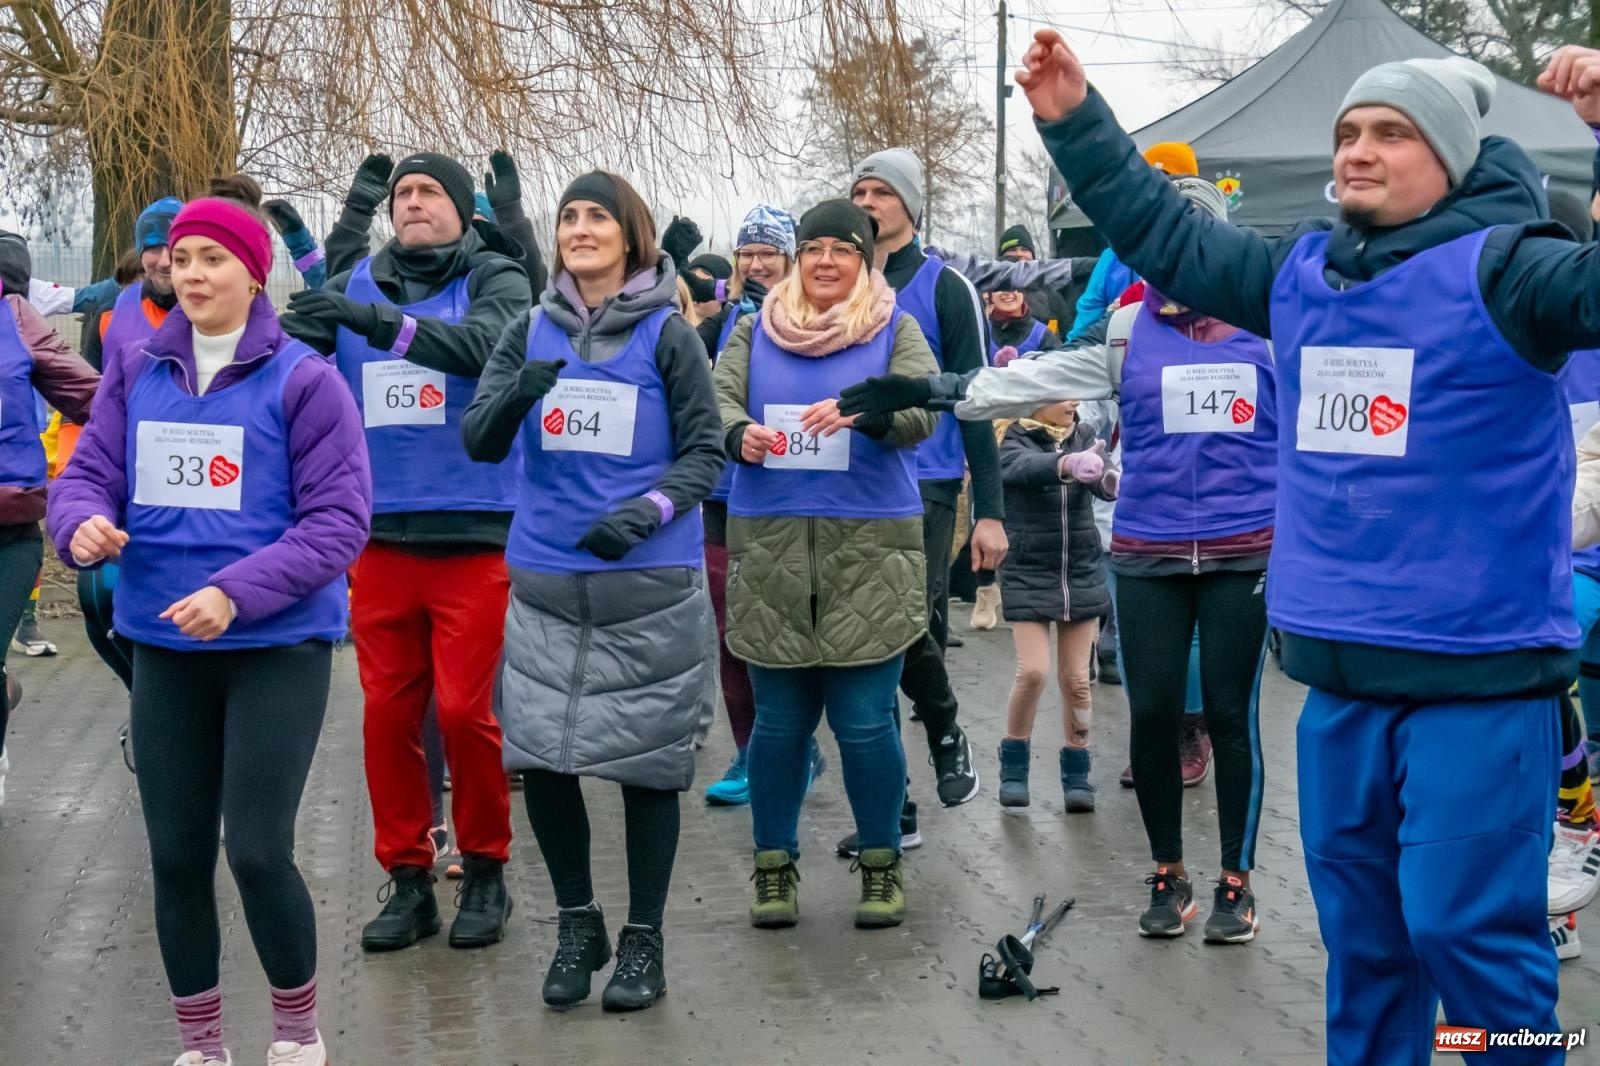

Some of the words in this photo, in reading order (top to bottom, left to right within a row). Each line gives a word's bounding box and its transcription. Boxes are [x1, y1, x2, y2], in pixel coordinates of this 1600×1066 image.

[386, 384, 416, 409] 65
[1185, 390, 1237, 415] 147
[567, 409, 602, 437] 64
[1314, 392, 1369, 432] 108
[789, 431, 821, 456] 84
[166, 455, 204, 487] 33
